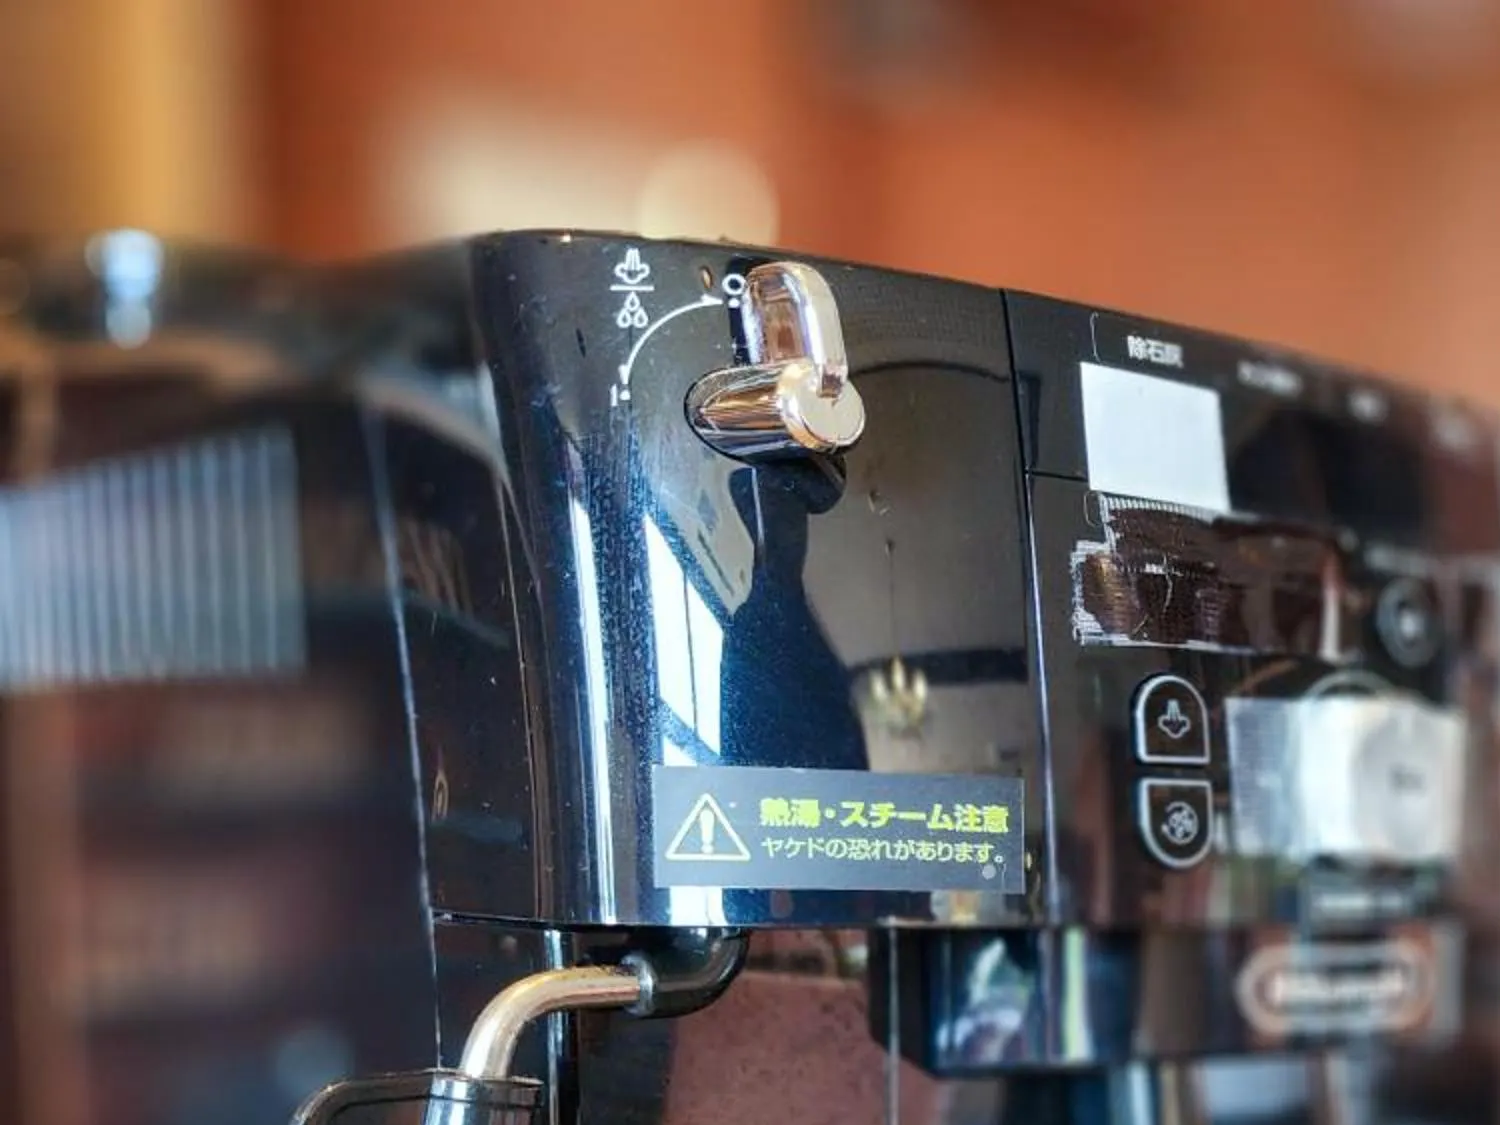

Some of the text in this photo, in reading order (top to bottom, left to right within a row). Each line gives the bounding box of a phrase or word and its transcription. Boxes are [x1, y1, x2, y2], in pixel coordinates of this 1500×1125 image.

[760, 797, 1009, 833] 熱湯・スチーム注意
[761, 837, 1004, 864] ヤケドの恐れがあります。
